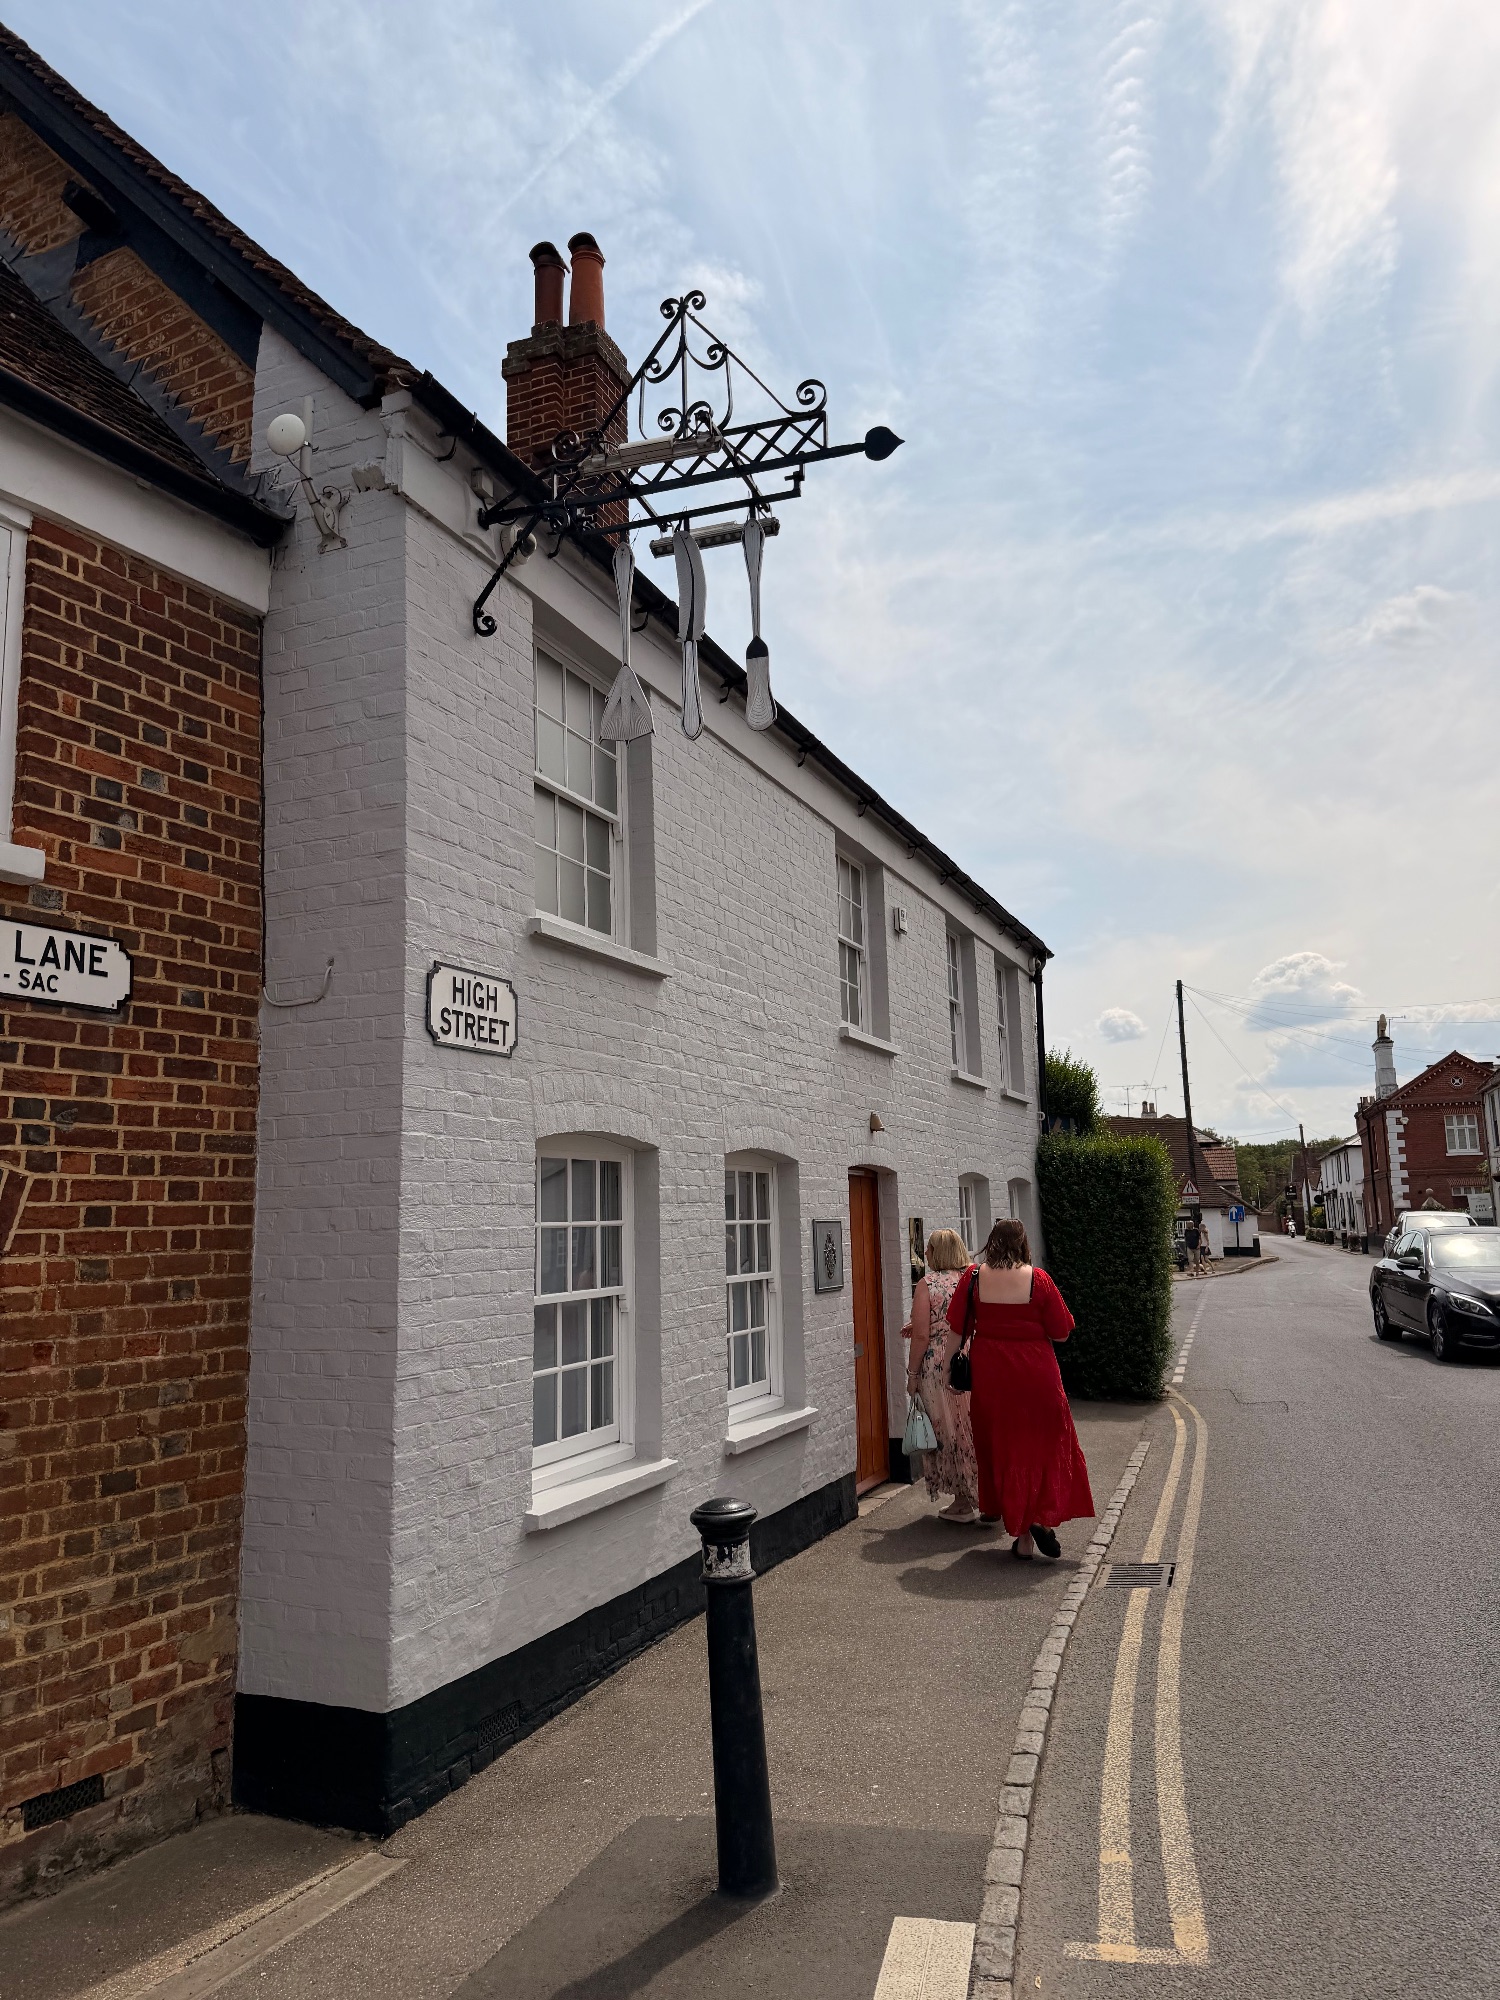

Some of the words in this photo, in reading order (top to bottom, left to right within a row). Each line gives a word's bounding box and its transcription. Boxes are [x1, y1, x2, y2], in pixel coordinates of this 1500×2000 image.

[14, 930, 108, 977] LANE
[18, 968, 59, 993] SAC
[452, 976, 497, 1013] HIGH
[439, 1007, 510, 1046] STREET
